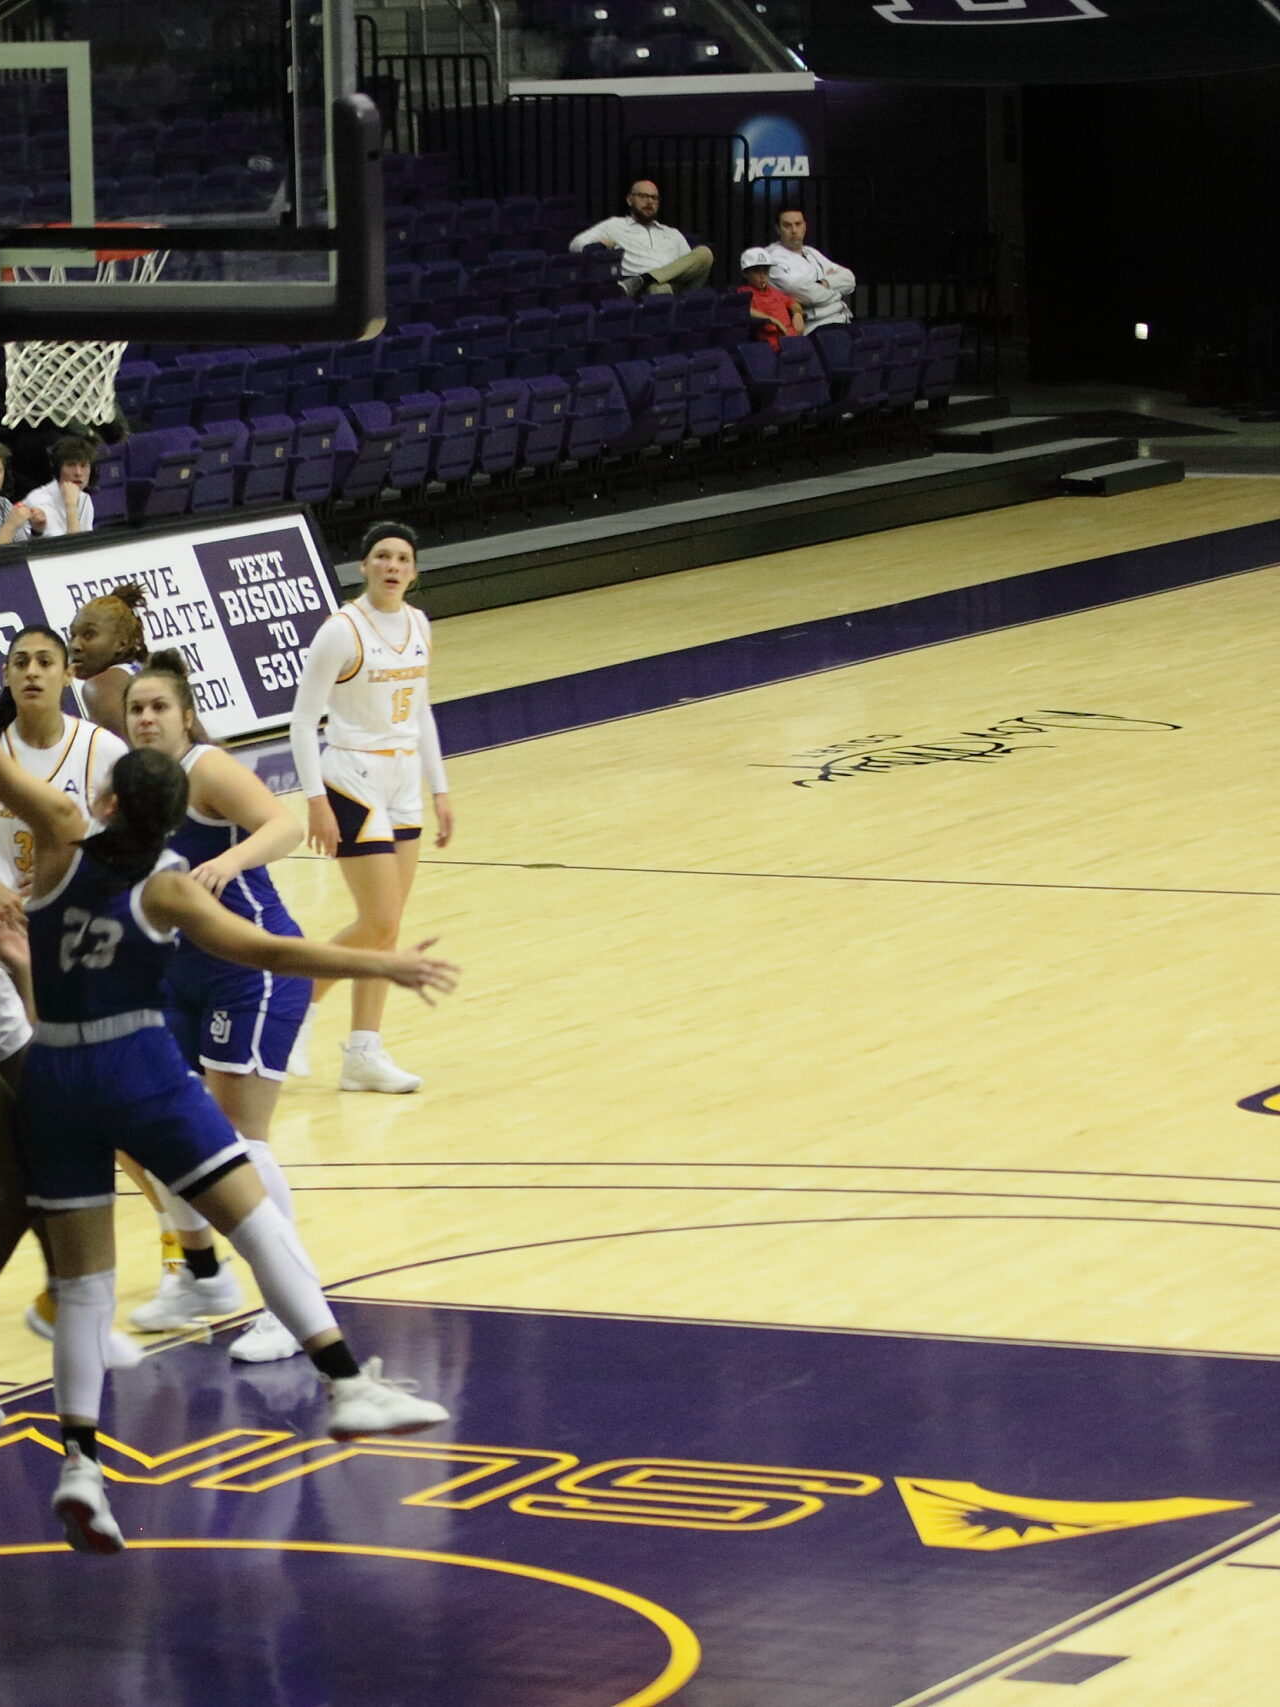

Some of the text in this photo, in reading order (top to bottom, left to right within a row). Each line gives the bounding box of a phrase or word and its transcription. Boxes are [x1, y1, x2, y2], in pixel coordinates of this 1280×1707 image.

[733, 155, 810, 183] NCAA
[228, 550, 286, 585] TEXT
[219, 576, 322, 627] BISONS
[267, 620, 300, 649] TO
[190, 677, 236, 713] RD!
[391, 687, 414, 724] 15
[59, 906, 124, 973] 23
